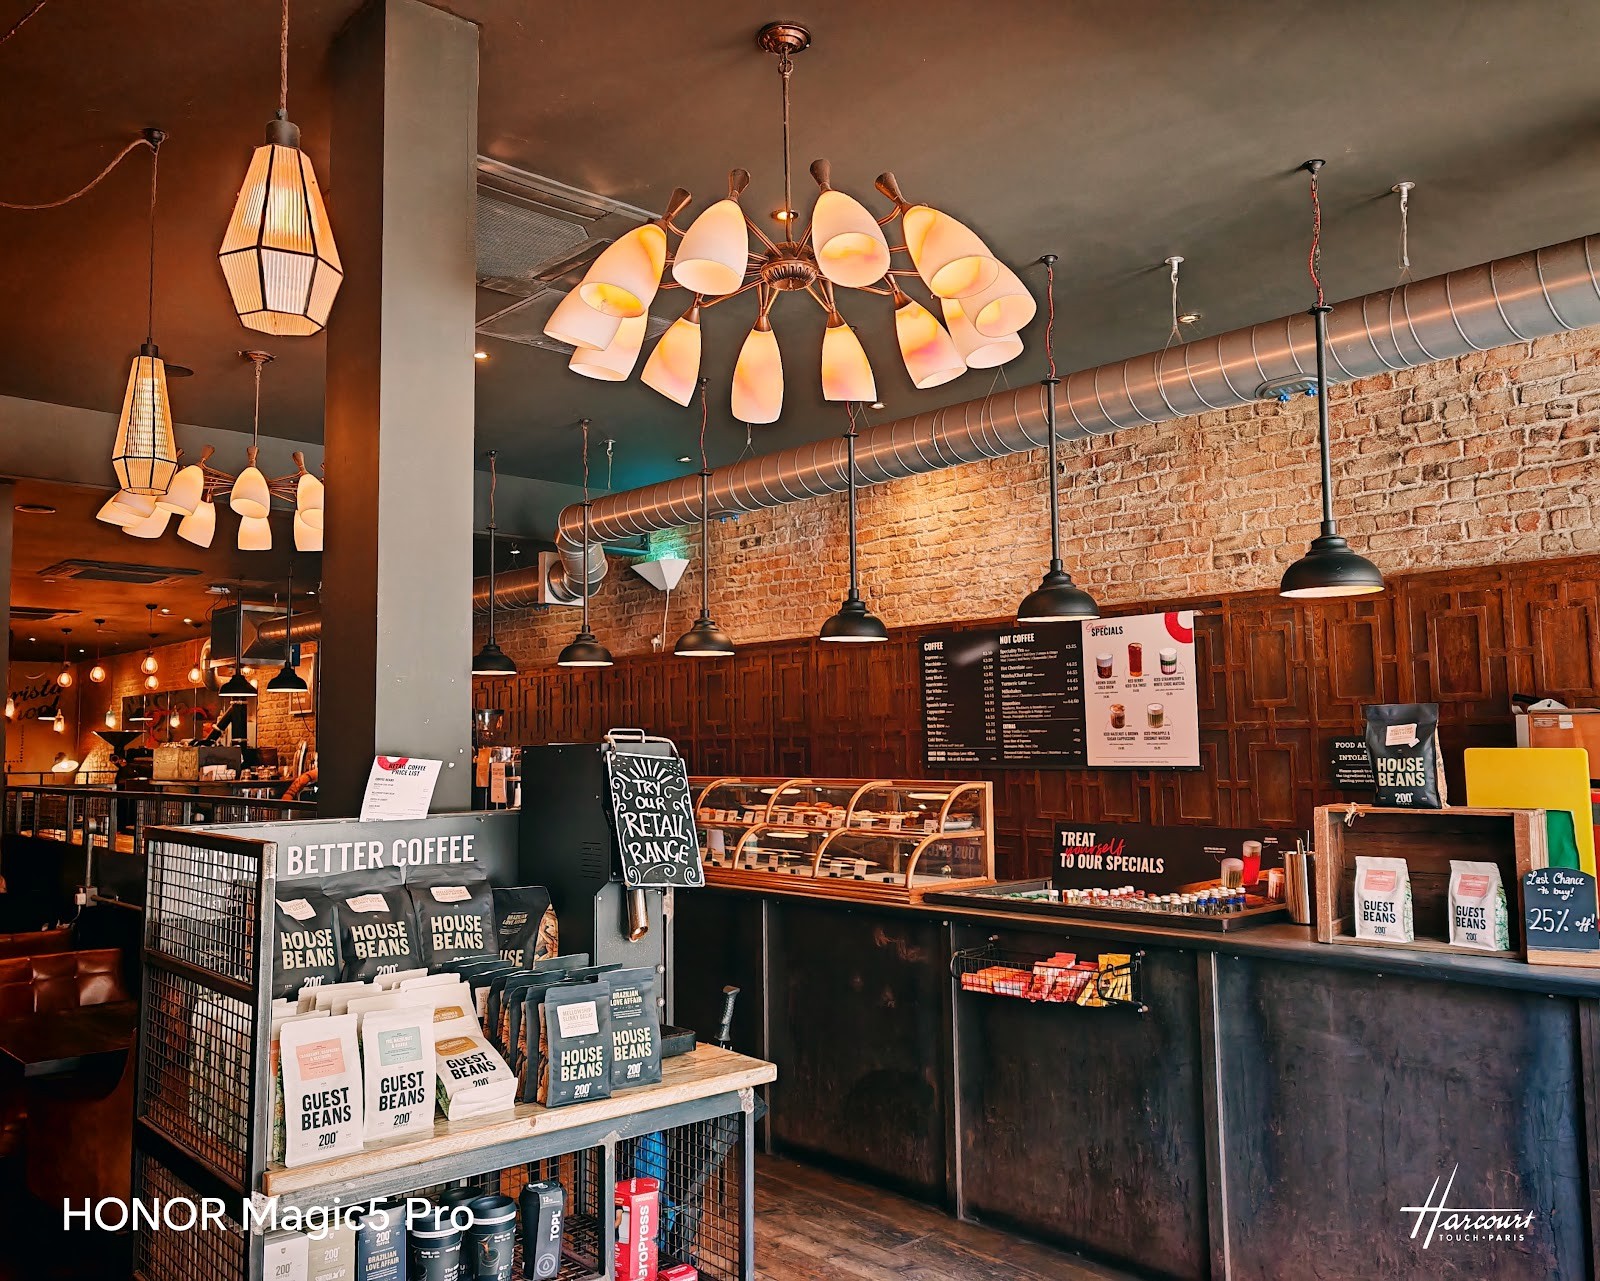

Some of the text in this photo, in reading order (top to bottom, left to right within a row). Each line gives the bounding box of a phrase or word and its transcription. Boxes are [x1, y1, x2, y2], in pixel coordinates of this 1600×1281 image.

[1000, 633, 1034, 644] NOT COFFEE
[1091, 626, 1124, 636] SPECIALS
[924, 642, 944, 651] COFFEE
[11, 680, 62, 701] rista
[1377, 757, 1425, 772] HOUSE
[632, 779, 661, 796] TRY
[1378, 772, 1426, 787] BEANS
[621, 812, 689, 842] RETAIL
[1061, 831, 1096, 847] TREAT
[287, 835, 475, 876] BETTER COFFEE
[628, 840, 690, 866] RANGE
[1065, 838, 1126, 859] yourself
[1060, 853, 1165, 874] TO OUR SPECIALS
[1526, 871, 1585, 885] Last Chance
[1537, 886, 1574, 900] to buy!
[1363, 900, 1394, 912] GUEST
[1456, 906, 1485, 918] GUEST
[431, 915, 483, 933] HOUSE
[1363, 911, 1396, 923] BEANS
[1456, 917, 1486, 930] BEANS
[1529, 908, 1595, 933] 25% off!
[280, 928, 334, 950] HOUSE
[351, 921, 408, 942] HOUSE
[354, 938, 410, 960] BEANS
[432, 933, 484, 951] BEANS
[282, 948, 335, 970] BEANS
[500, 949, 524, 967] USE
[610, 996, 642, 1006] LOVE AFFAIR
[612, 990, 639, 999] BRAZILIAN
[562, 1008, 591, 1016] MELLOWSHIP
[580, 1012, 593, 1020] DECAF
[612, 1027, 652, 1046] HOUSE
[446, 1052, 488, 1069] GUEST
[561, 1046, 603, 1066] HOUSE
[613, 1042, 652, 1062] BEANS
[450, 1061, 496, 1080] BEANS
[560, 1061, 603, 1082] BEANS
[381, 1071, 424, 1094] GUEST
[302, 1087, 349, 1112] GUEST
[379, 1088, 425, 1112] BEANS
[302, 1105, 351, 1131] BEANS
[366, 1257, 399, 1272] LOVE AFFAIR
[368, 1250, 397, 1263] BRAZILIAN
